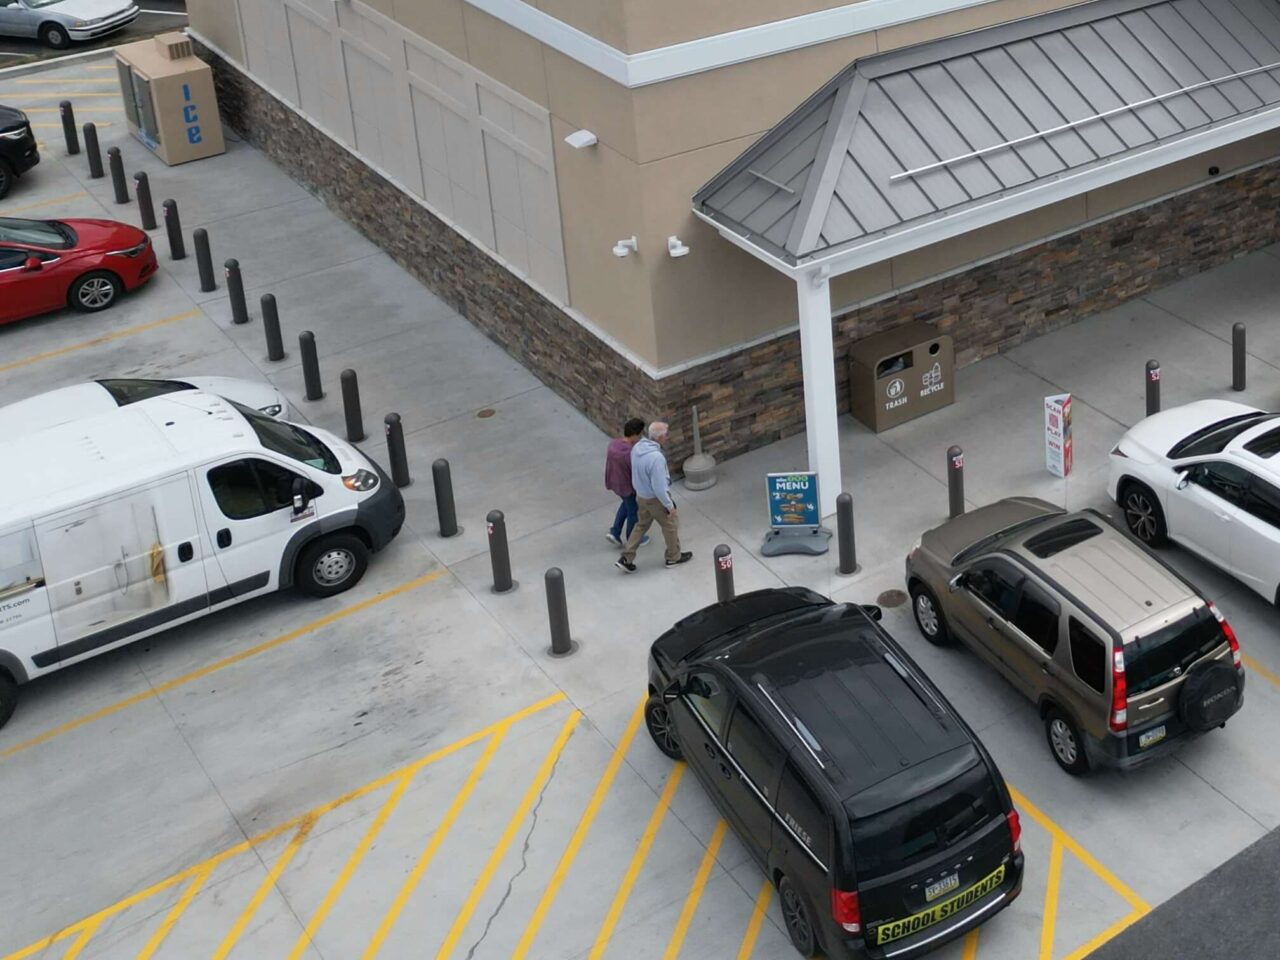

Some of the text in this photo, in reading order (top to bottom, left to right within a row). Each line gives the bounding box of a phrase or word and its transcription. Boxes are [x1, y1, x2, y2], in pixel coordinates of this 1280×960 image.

[920, 382, 945, 397] RECYCLE
[885, 396, 908, 411] TRASH
[1045, 402, 1062, 415] SCAN
[1046, 426, 1062, 438] PLAY
[1047, 440, 1061, 451] WIN
[775, 481, 809, 490] MENU
[1203, 686, 1237, 708] HONDA
[881, 869, 1003, 942] SCHOOL STUDENTS
